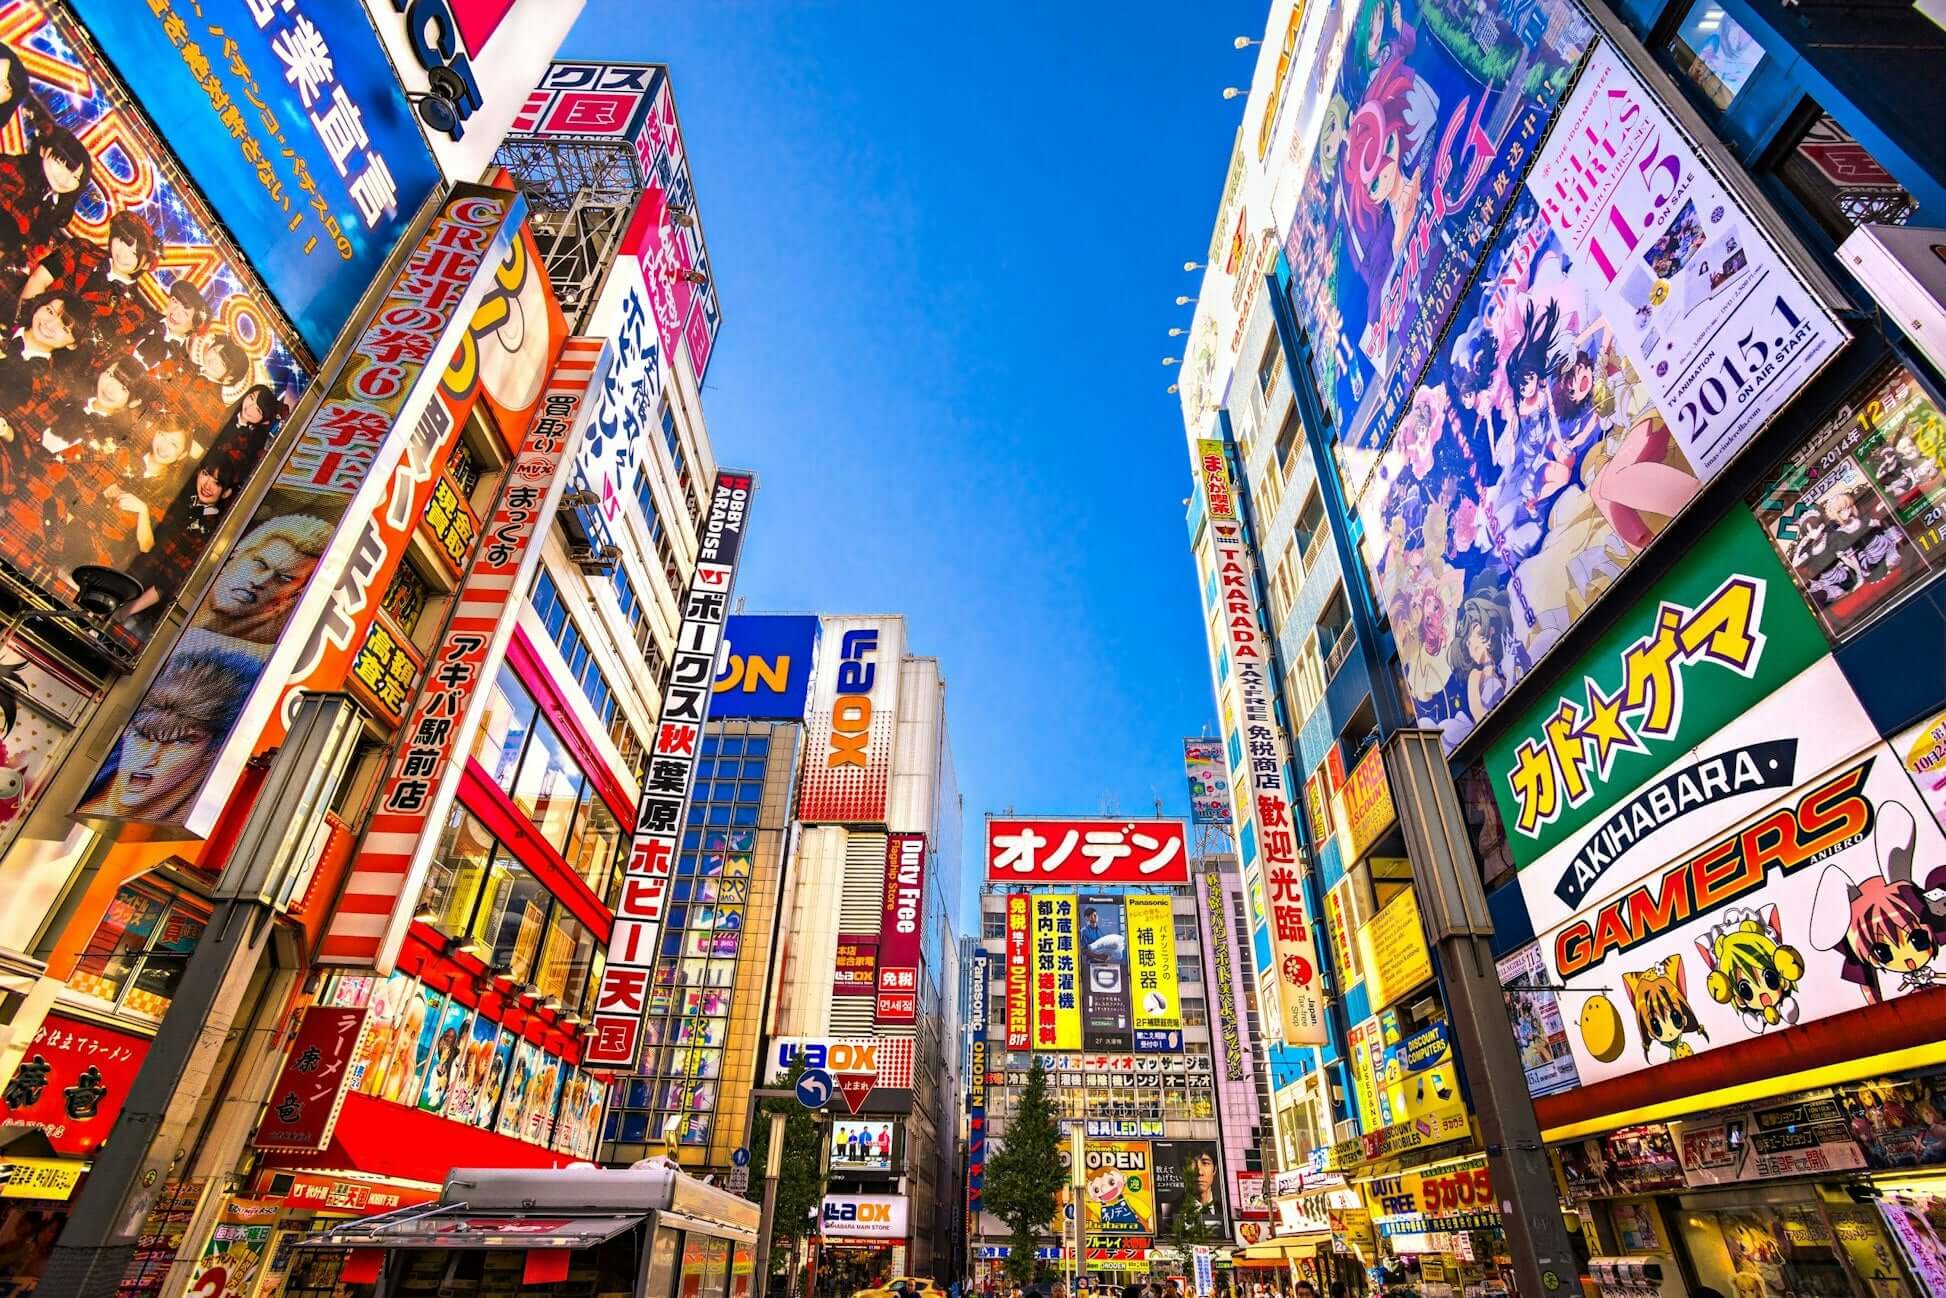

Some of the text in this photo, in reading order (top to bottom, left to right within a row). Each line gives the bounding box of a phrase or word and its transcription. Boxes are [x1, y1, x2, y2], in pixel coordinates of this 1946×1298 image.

[1561, 98, 1641, 230] GIRLS
[1585, 133, 1682, 288] 11.5
[1657, 172, 1695, 226] ON SALE
[1667, 350, 1716, 408] TV ANIMATION
[1678, 295, 1807, 445] 2015.1
[1737, 320, 1813, 404] ON AIR START
[531, 394, 579, 455] 買取り
[1704, 407, 1762, 469] imas-cinderella.com
[1819, 429, 1862, 470] 2014年
[1856, 382, 1911, 432] 12月号
[726, 478, 750, 534] HOBBY
[1203, 455, 1233, 516] まんが喫茶
[485, 486, 543, 569] まっくす
[700, 475, 732, 560] PARADISE
[1219, 549, 1260, 658] TAKARADA
[386, 634, 485, 812] アキバ駅前店
[1247, 724, 1281, 790] 免税商店
[992, 823, 1182, 875] オノデン
[1573, 749, 1766, 893] AKIHABARA
[1809, 832, 1864, 866] ANIBRO
[886, 838, 901, 911] Flagship Store
[895, 839, 924, 934] Duty Free
[1258, 794, 1308, 943] 歓迎光臨
[1554, 756, 1878, 980] GAMERS
[1009, 898, 1027, 930] 免税
[1129, 898, 1168, 906] Panasonic
[882, 971, 914, 987] 免税
[1055, 899, 1075, 1009] 冷蔵庫洗濯機
[1137, 927, 1157, 989] 補聴器
[1159, 925, 1171, 980] パナソニックの
[880, 999, 913, 1012] 면세점
[1009, 965, 1028, 1034] DUTYFREE
[1291, 1005, 1300, 1027] Shop
[1308, 997, 1318, 1027] Japan
[310, 1013, 357, 1103] ラーメン
[973, 956, 986, 1107] Panasonic ONODEN
[1407, 1027, 1441, 1053] DISCOUNT
[1407, 1038, 1447, 1065] COMPUTERS
[843, 1080, 870, 1092] 止まれ
[1060, 1151, 1145, 1169] OODEN
[1156, 1166, 1174, 1174] 教えて
[1370, 1176, 1402, 1197] DUTY
[1382, 1193, 1417, 1215] FREE
